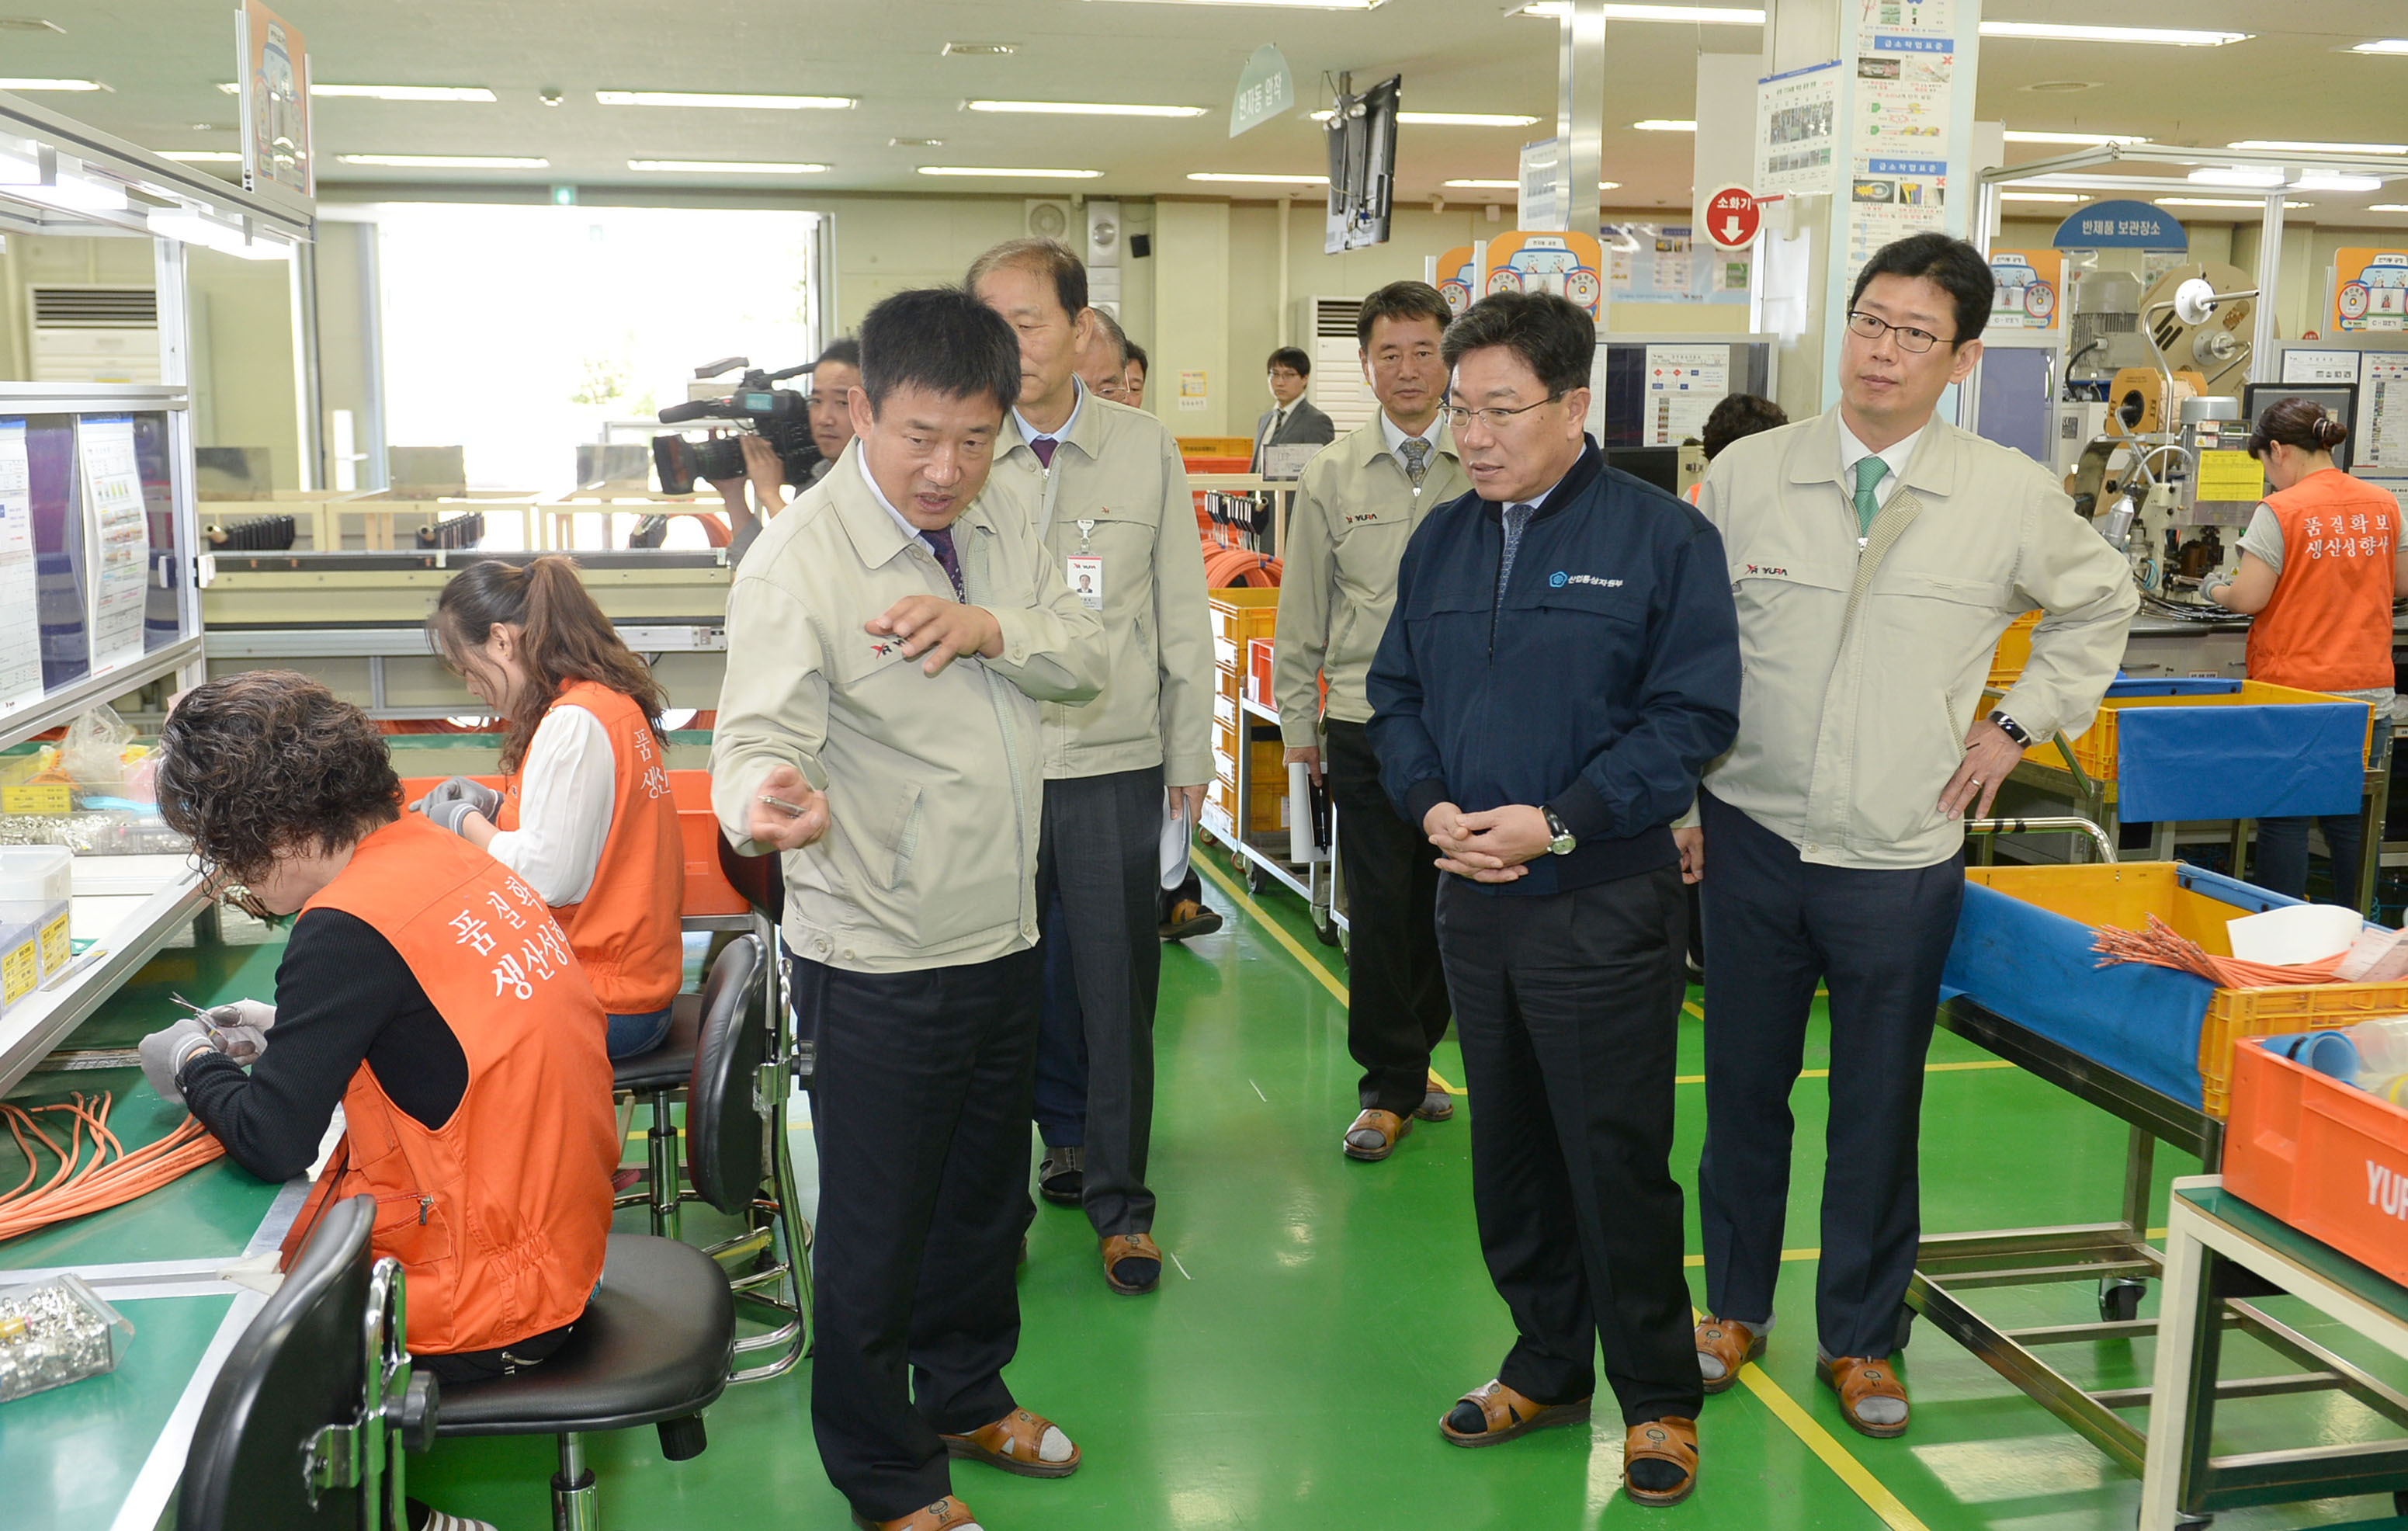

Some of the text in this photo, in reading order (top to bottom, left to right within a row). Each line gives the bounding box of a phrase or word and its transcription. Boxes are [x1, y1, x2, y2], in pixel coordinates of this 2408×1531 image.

[1716, 196, 1751, 211] 소화기
[2082, 220, 2161, 236] 반제품 보관장소
[1762, 567, 1788, 576] YURA
